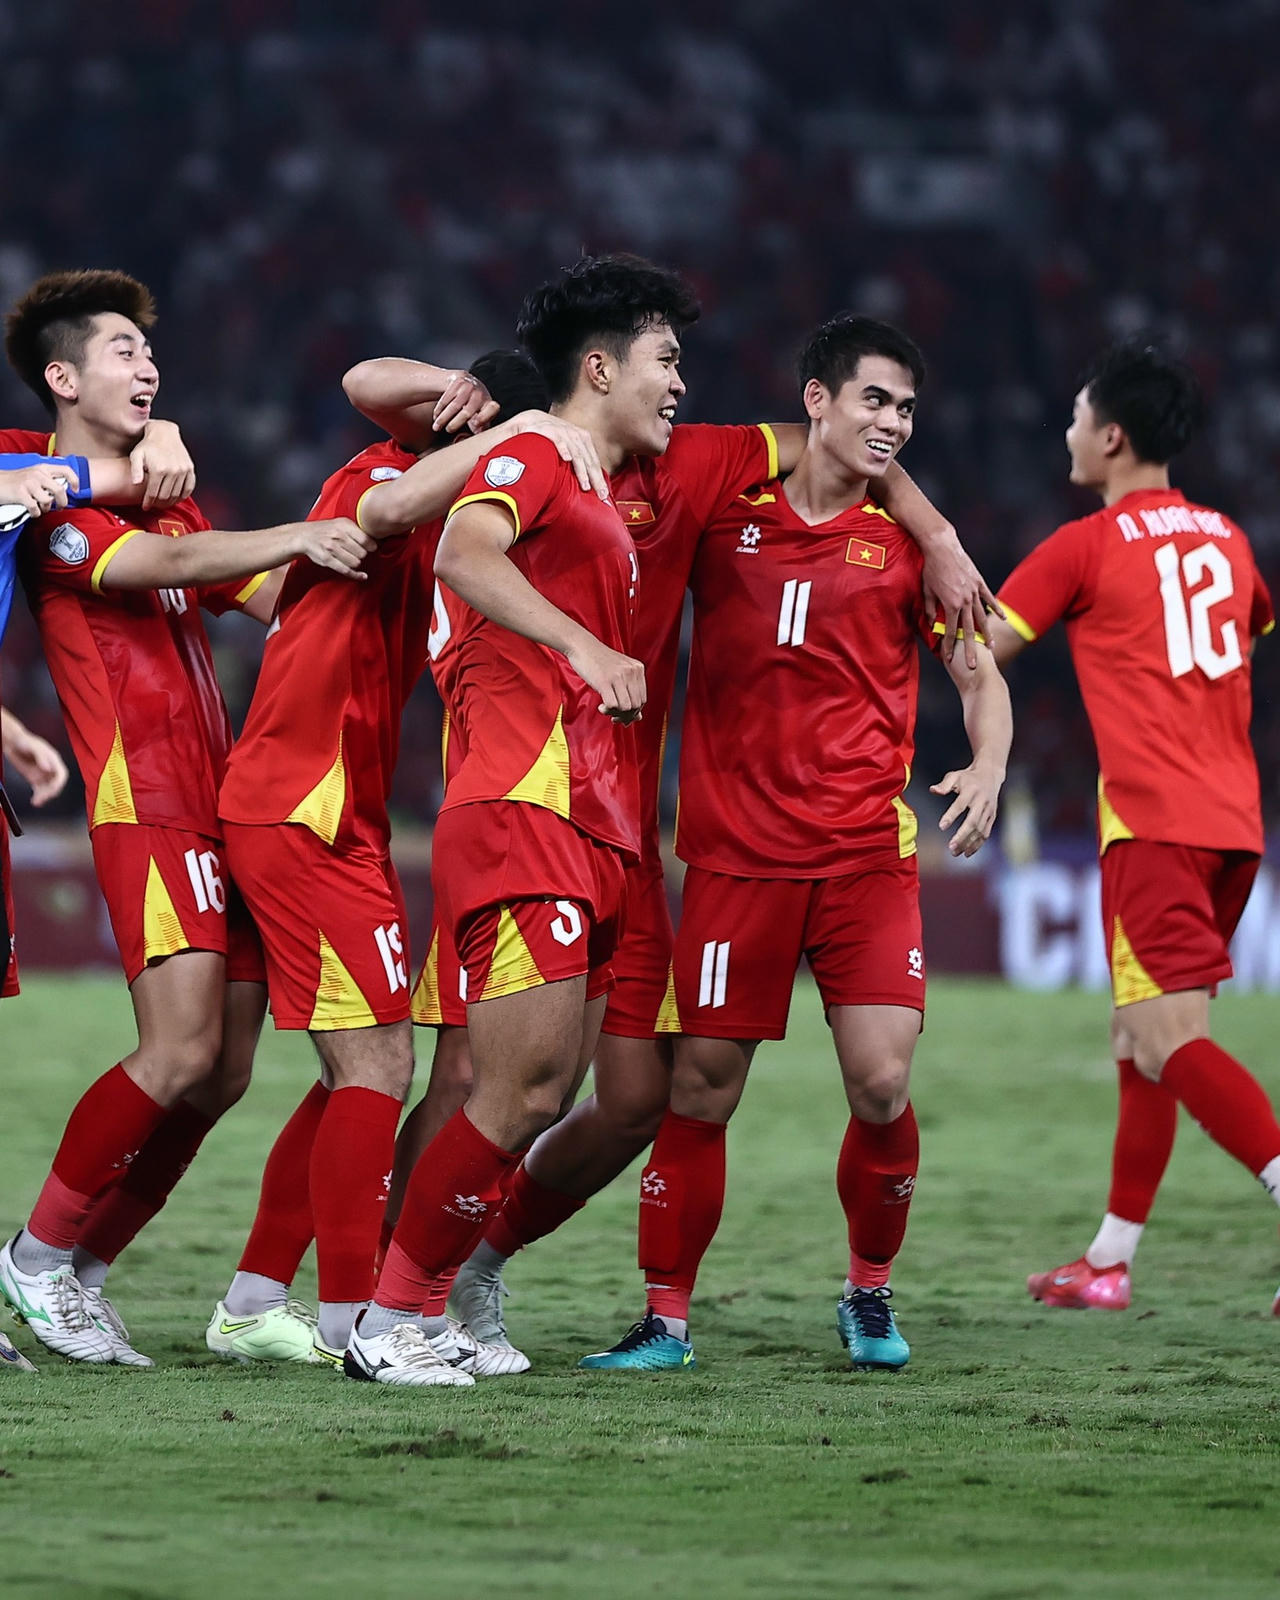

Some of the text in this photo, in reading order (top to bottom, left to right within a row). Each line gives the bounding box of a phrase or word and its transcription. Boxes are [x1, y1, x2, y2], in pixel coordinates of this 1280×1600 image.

[776, 578, 813, 648] 11
[1154, 540, 1243, 682] 12
[183, 847, 226, 915] 16
[698, 940, 732, 1009] 11
